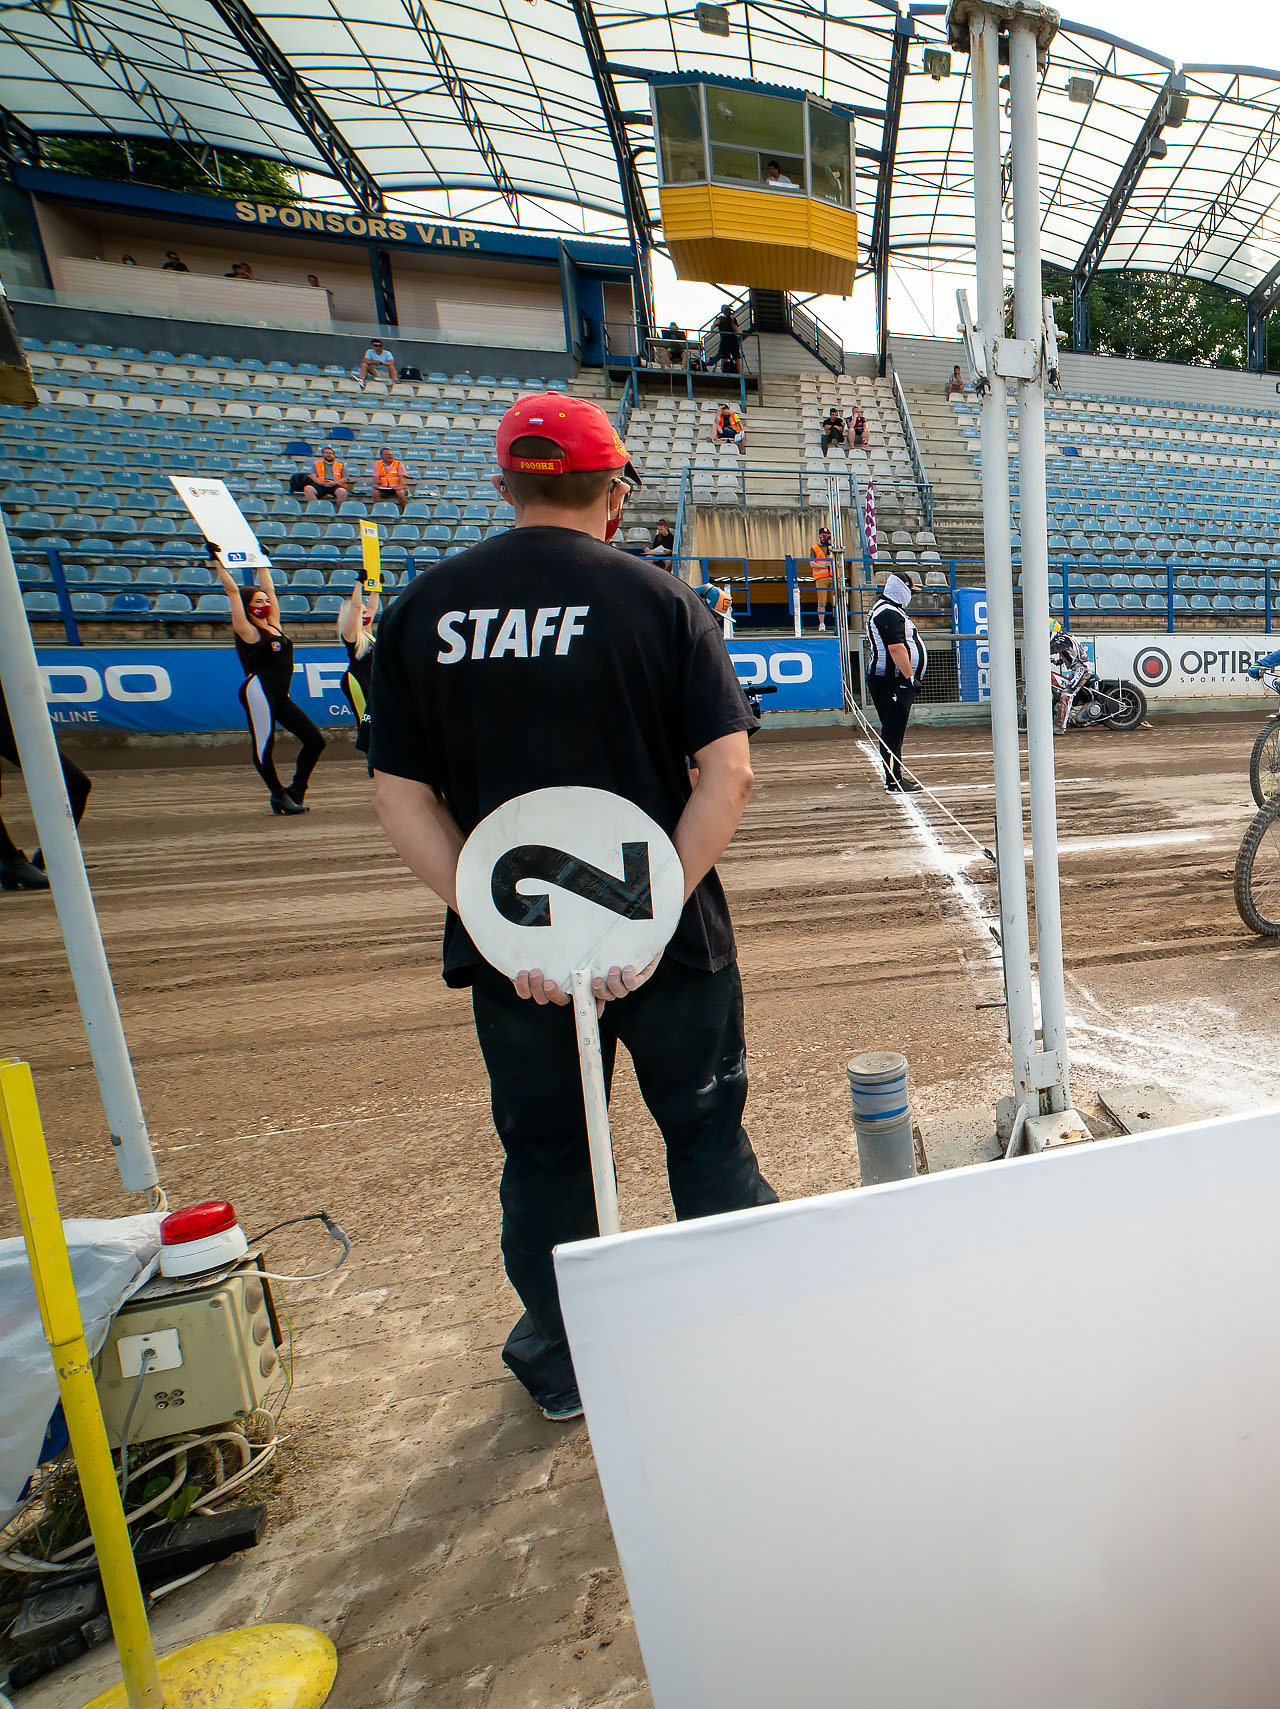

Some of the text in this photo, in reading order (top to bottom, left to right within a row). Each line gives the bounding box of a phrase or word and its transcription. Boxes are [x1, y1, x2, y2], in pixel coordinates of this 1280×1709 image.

[235, 201, 480, 249] SPONSORS V.I.P.
[436, 606, 590, 664] STAFF
[38, 664, 172, 703] DO
[731, 652, 813, 684] DO
[50, 711, 99, 722] NLINE
[329, 705, 350, 715] CA
[491, 841, 654, 927] 2
